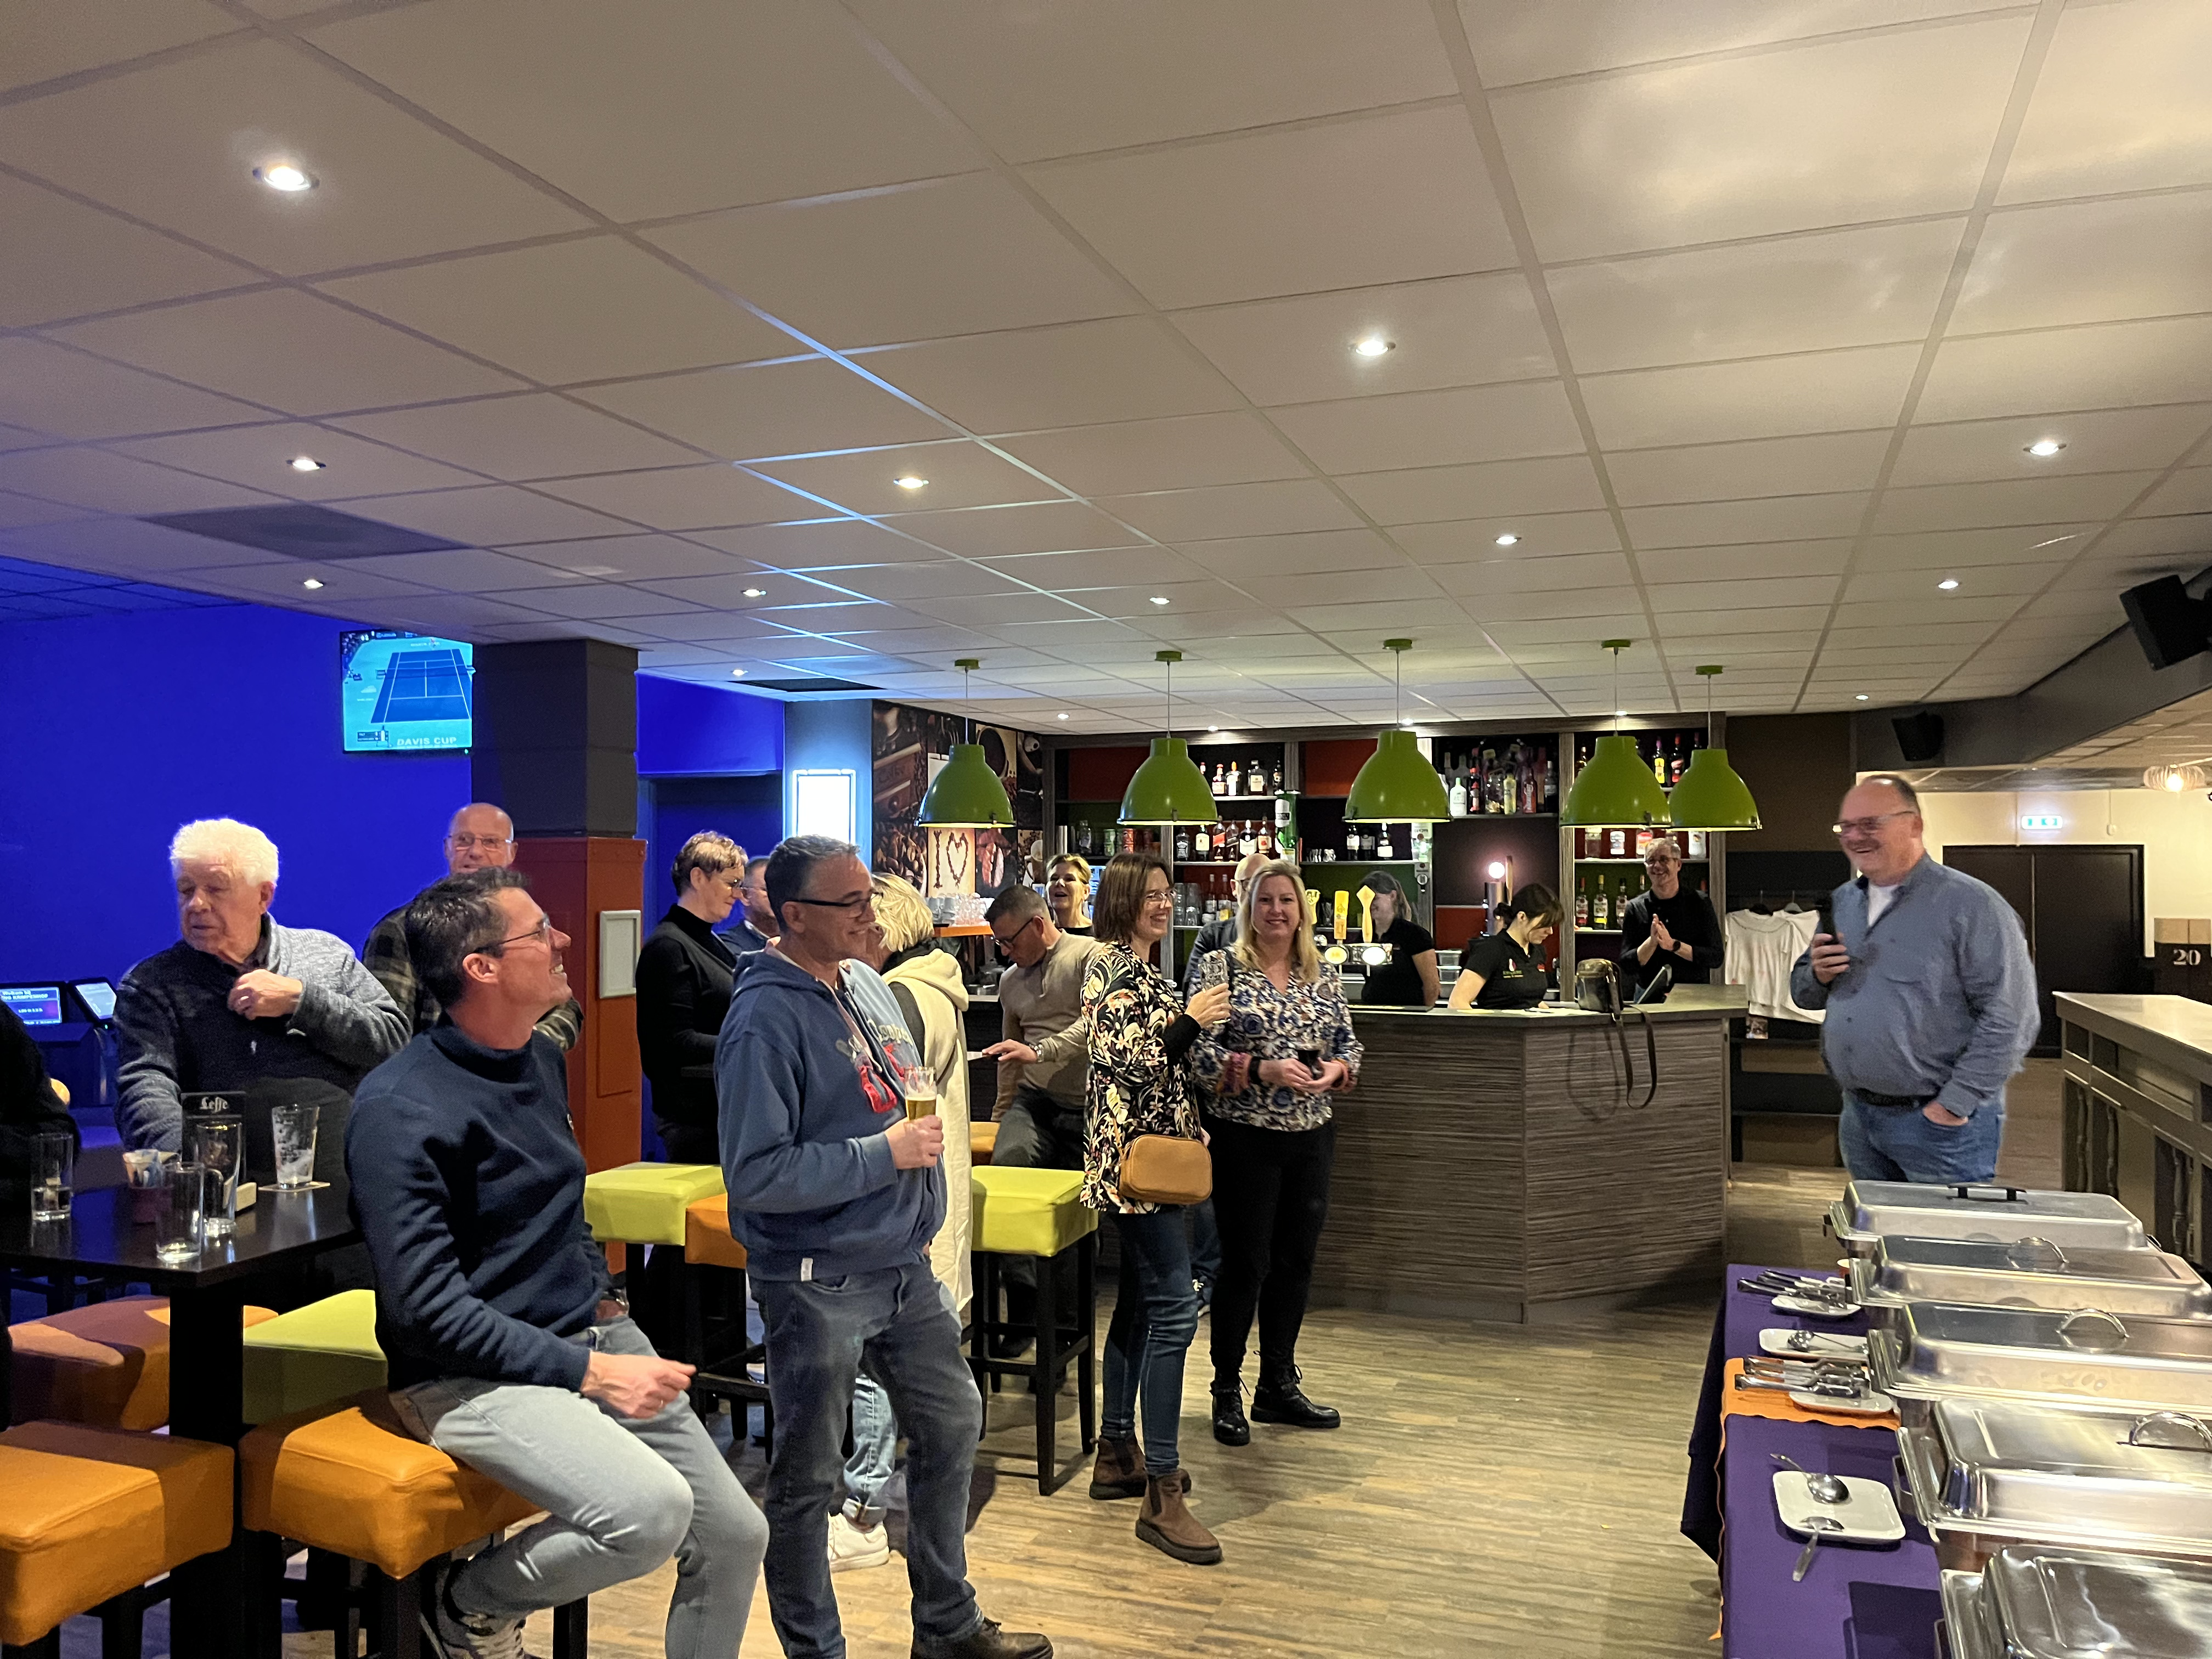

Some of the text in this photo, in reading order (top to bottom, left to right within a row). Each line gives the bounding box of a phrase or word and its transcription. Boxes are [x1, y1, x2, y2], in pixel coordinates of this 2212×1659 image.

[397, 737, 430, 746] DAVIS
[2173, 949, 2201, 966] 20
[199, 1097, 229, 1113] Leffe
